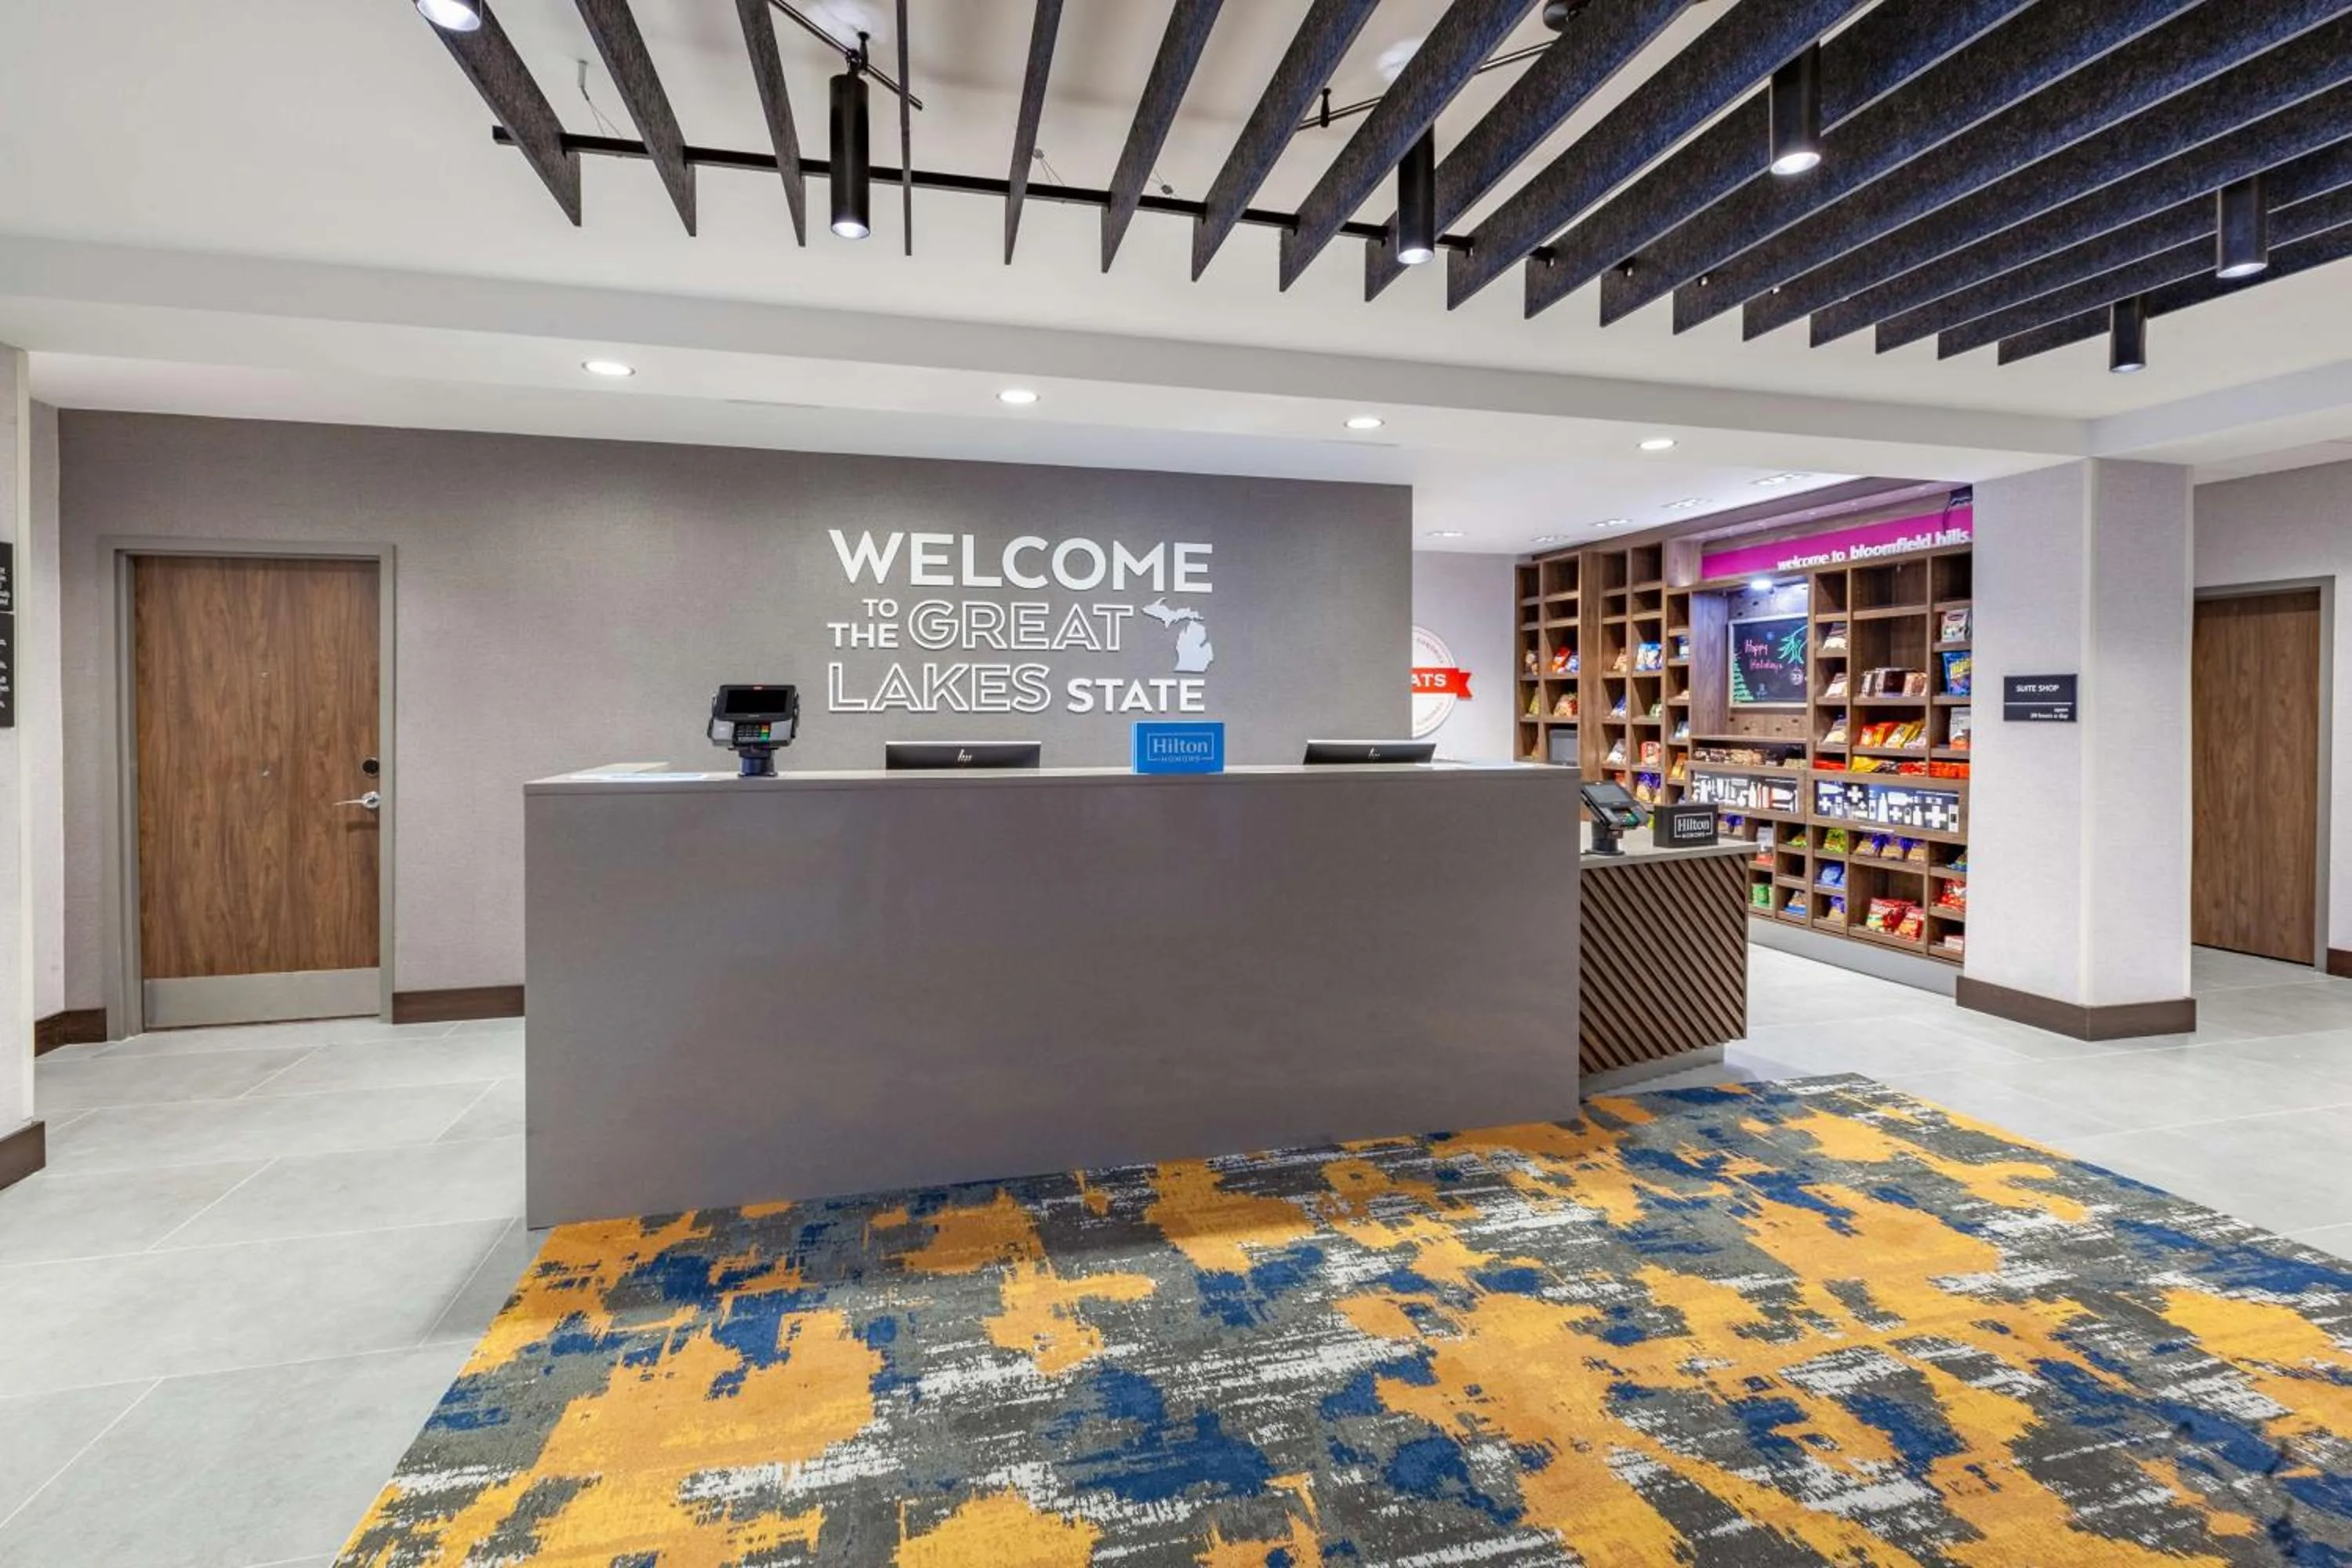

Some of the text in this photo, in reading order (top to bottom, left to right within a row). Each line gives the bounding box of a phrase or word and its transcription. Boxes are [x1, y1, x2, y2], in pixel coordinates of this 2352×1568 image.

[828, 529, 1213, 593] WELCOME
[1777, 554, 1829, 571] welcome
[1831, 550, 1846, 562] to
[1850, 533, 1931, 560] bloomfield
[828, 599, 1134, 652] THE GREAT
[862, 599, 898, 618] TO
[828, 662, 1206, 713] LAKES STATE
[1152, 738, 1208, 753] Hilton
[1677, 818, 1710, 832] Hilton
